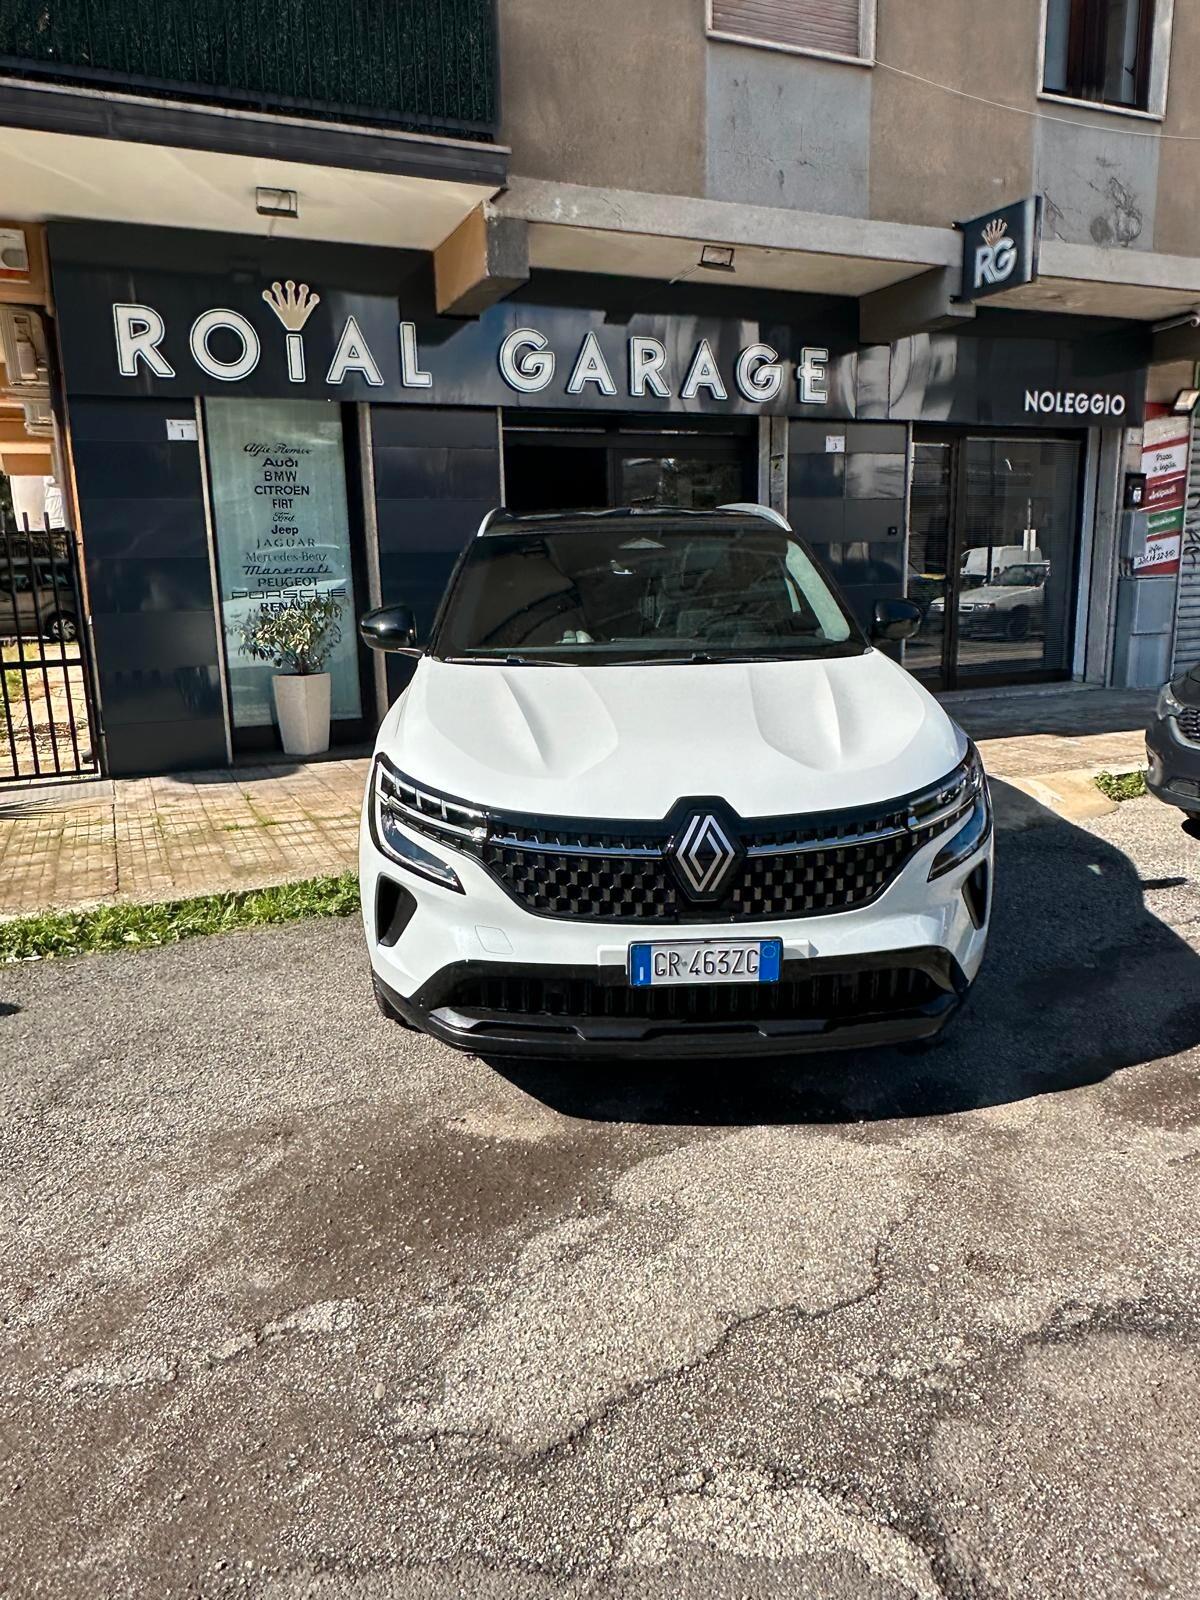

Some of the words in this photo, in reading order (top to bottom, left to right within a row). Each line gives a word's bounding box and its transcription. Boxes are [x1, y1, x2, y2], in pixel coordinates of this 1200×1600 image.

[974, 236, 1018, 289] RG
[499, 327, 829, 404] GARAGE
[1024, 389, 1126, 416] NOLEGGIO
[262, 457, 299, 468] Audi
[264, 470, 297, 482] BMW
[272, 498, 294, 509] FIAT
[271, 525, 299, 536] Jeep
[256, 538, 316, 549] JAGUAR
[246, 551, 327, 563] Mercedes-Benz
[242, 563, 334, 576] Maserati
[257, 576, 319, 588] PEUGEOT
[231, 588, 346, 600] PORSCHE
